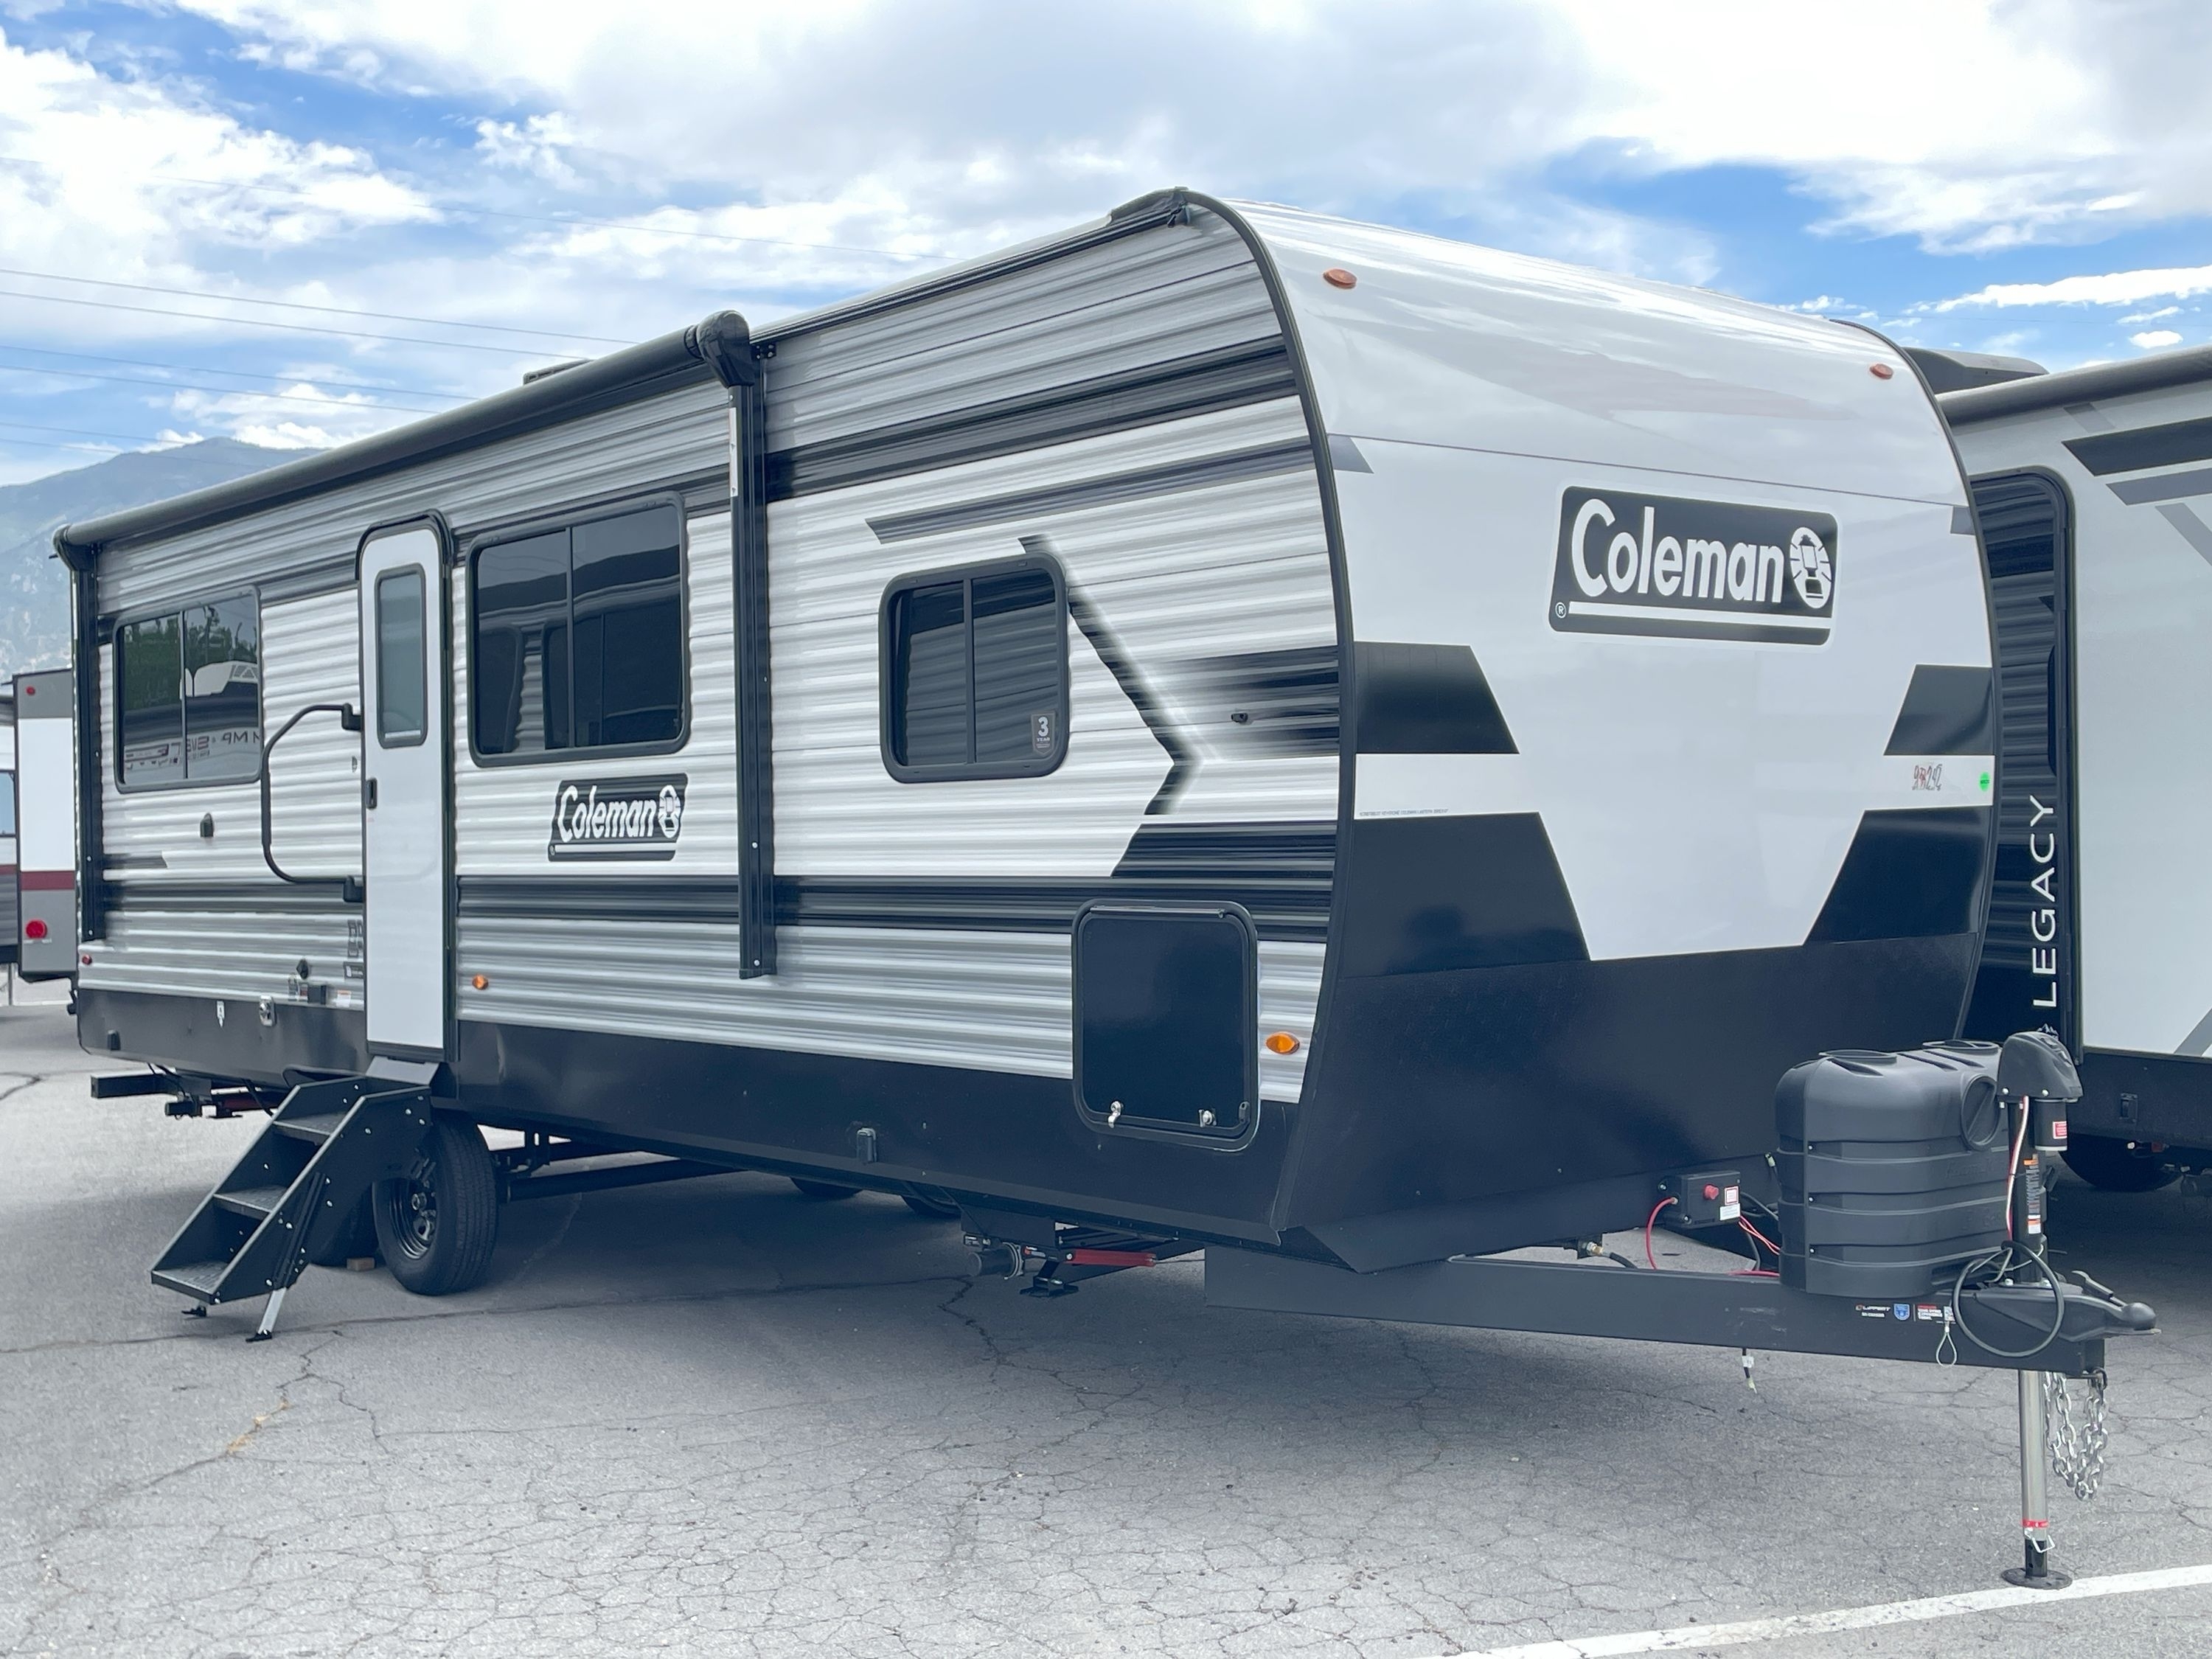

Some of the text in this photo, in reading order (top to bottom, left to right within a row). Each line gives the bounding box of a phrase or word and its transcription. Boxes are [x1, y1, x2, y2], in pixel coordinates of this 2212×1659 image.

[1571, 498, 1784, 604] Coleman
[1037, 716, 1048, 737] 3
[557, 785, 657, 843] Coleman
[2029, 795, 2057, 1007] LEGACY
